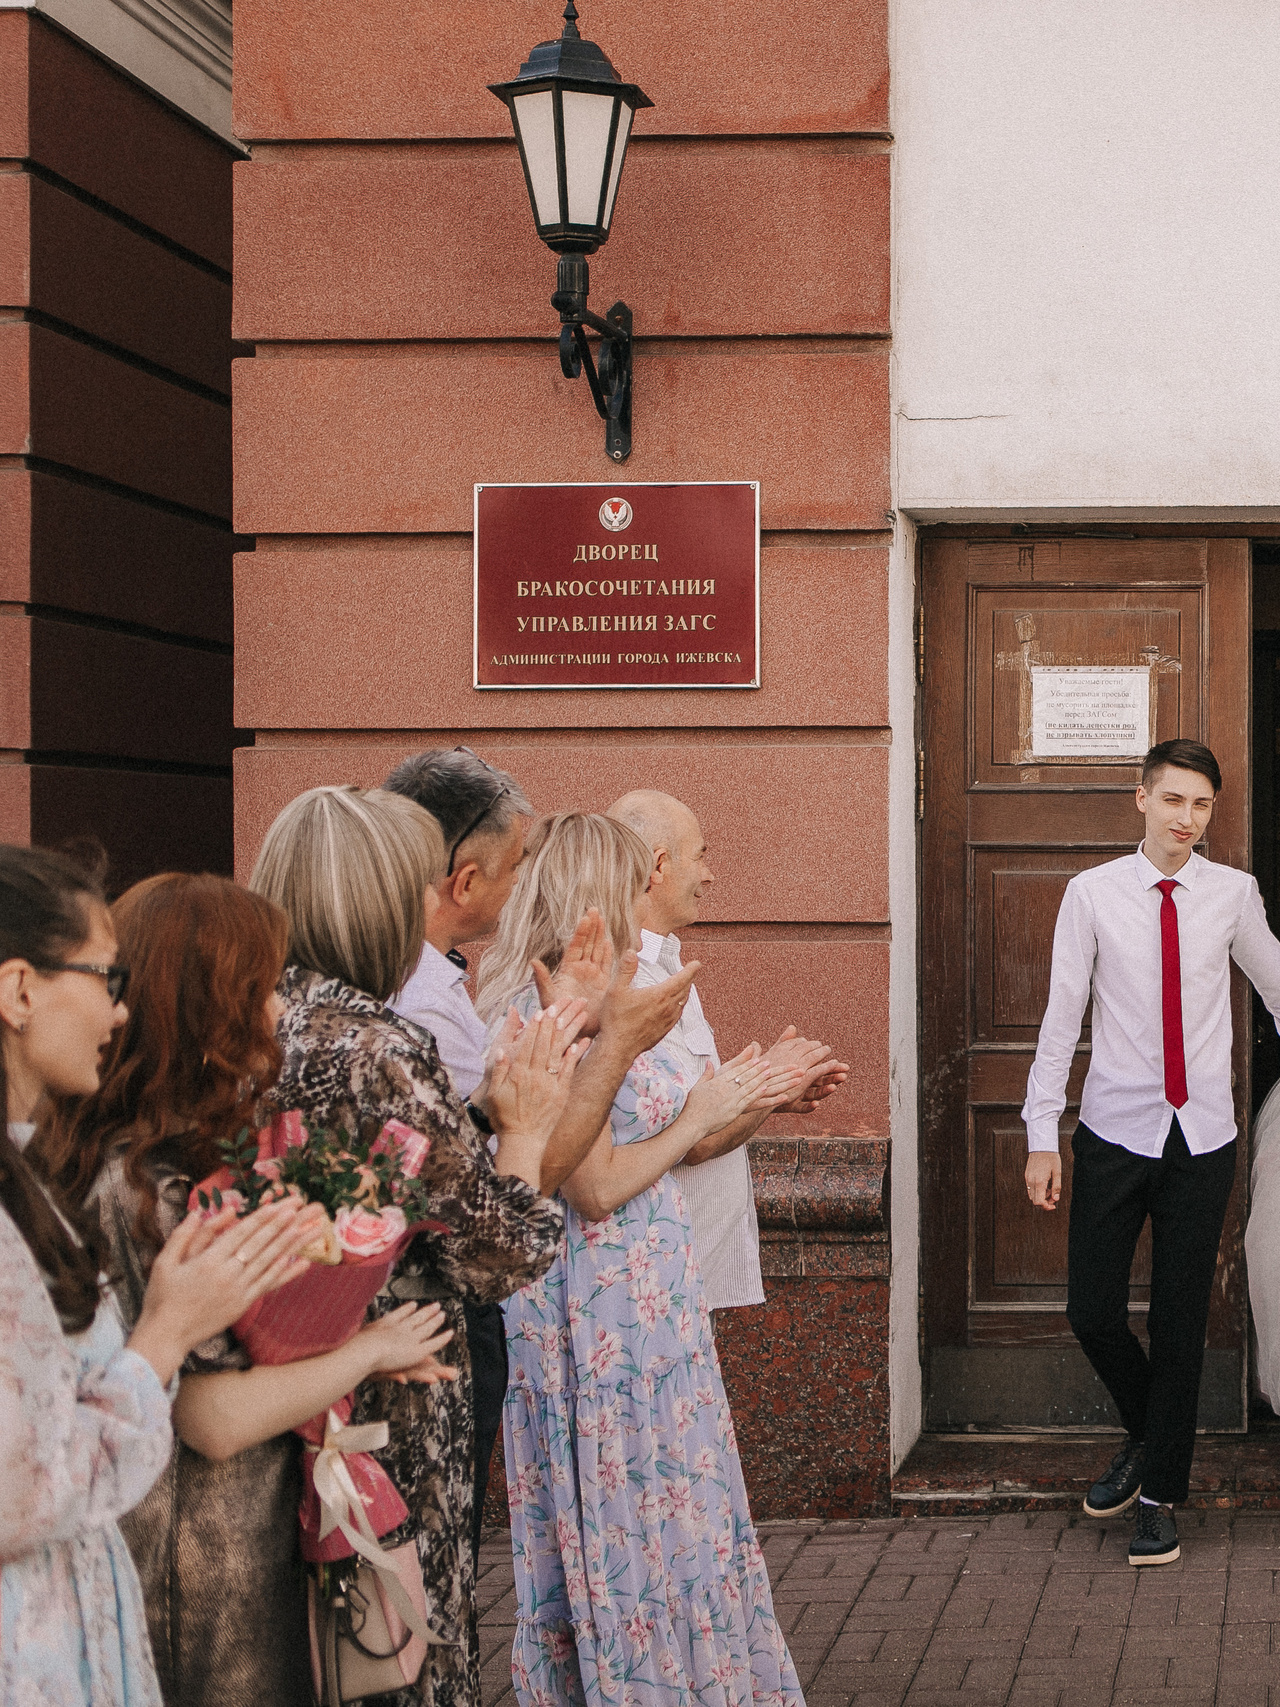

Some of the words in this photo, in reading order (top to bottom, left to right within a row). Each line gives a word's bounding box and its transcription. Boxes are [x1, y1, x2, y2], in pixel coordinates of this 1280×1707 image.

[573, 544, 659, 563] ДВОРЕЦ
[517, 579, 716, 597] БРАКОСОЧЕТАНИЯ
[516, 615, 658, 633] УПРАВЛЕНИЯ
[663, 614, 717, 631] ЗАГС
[490, 653, 611, 666] АДМИНИСТРАЦИИ
[618, 653, 669, 665] ГОРОДА
[676, 652, 742, 663] ИЖЕВСКА
